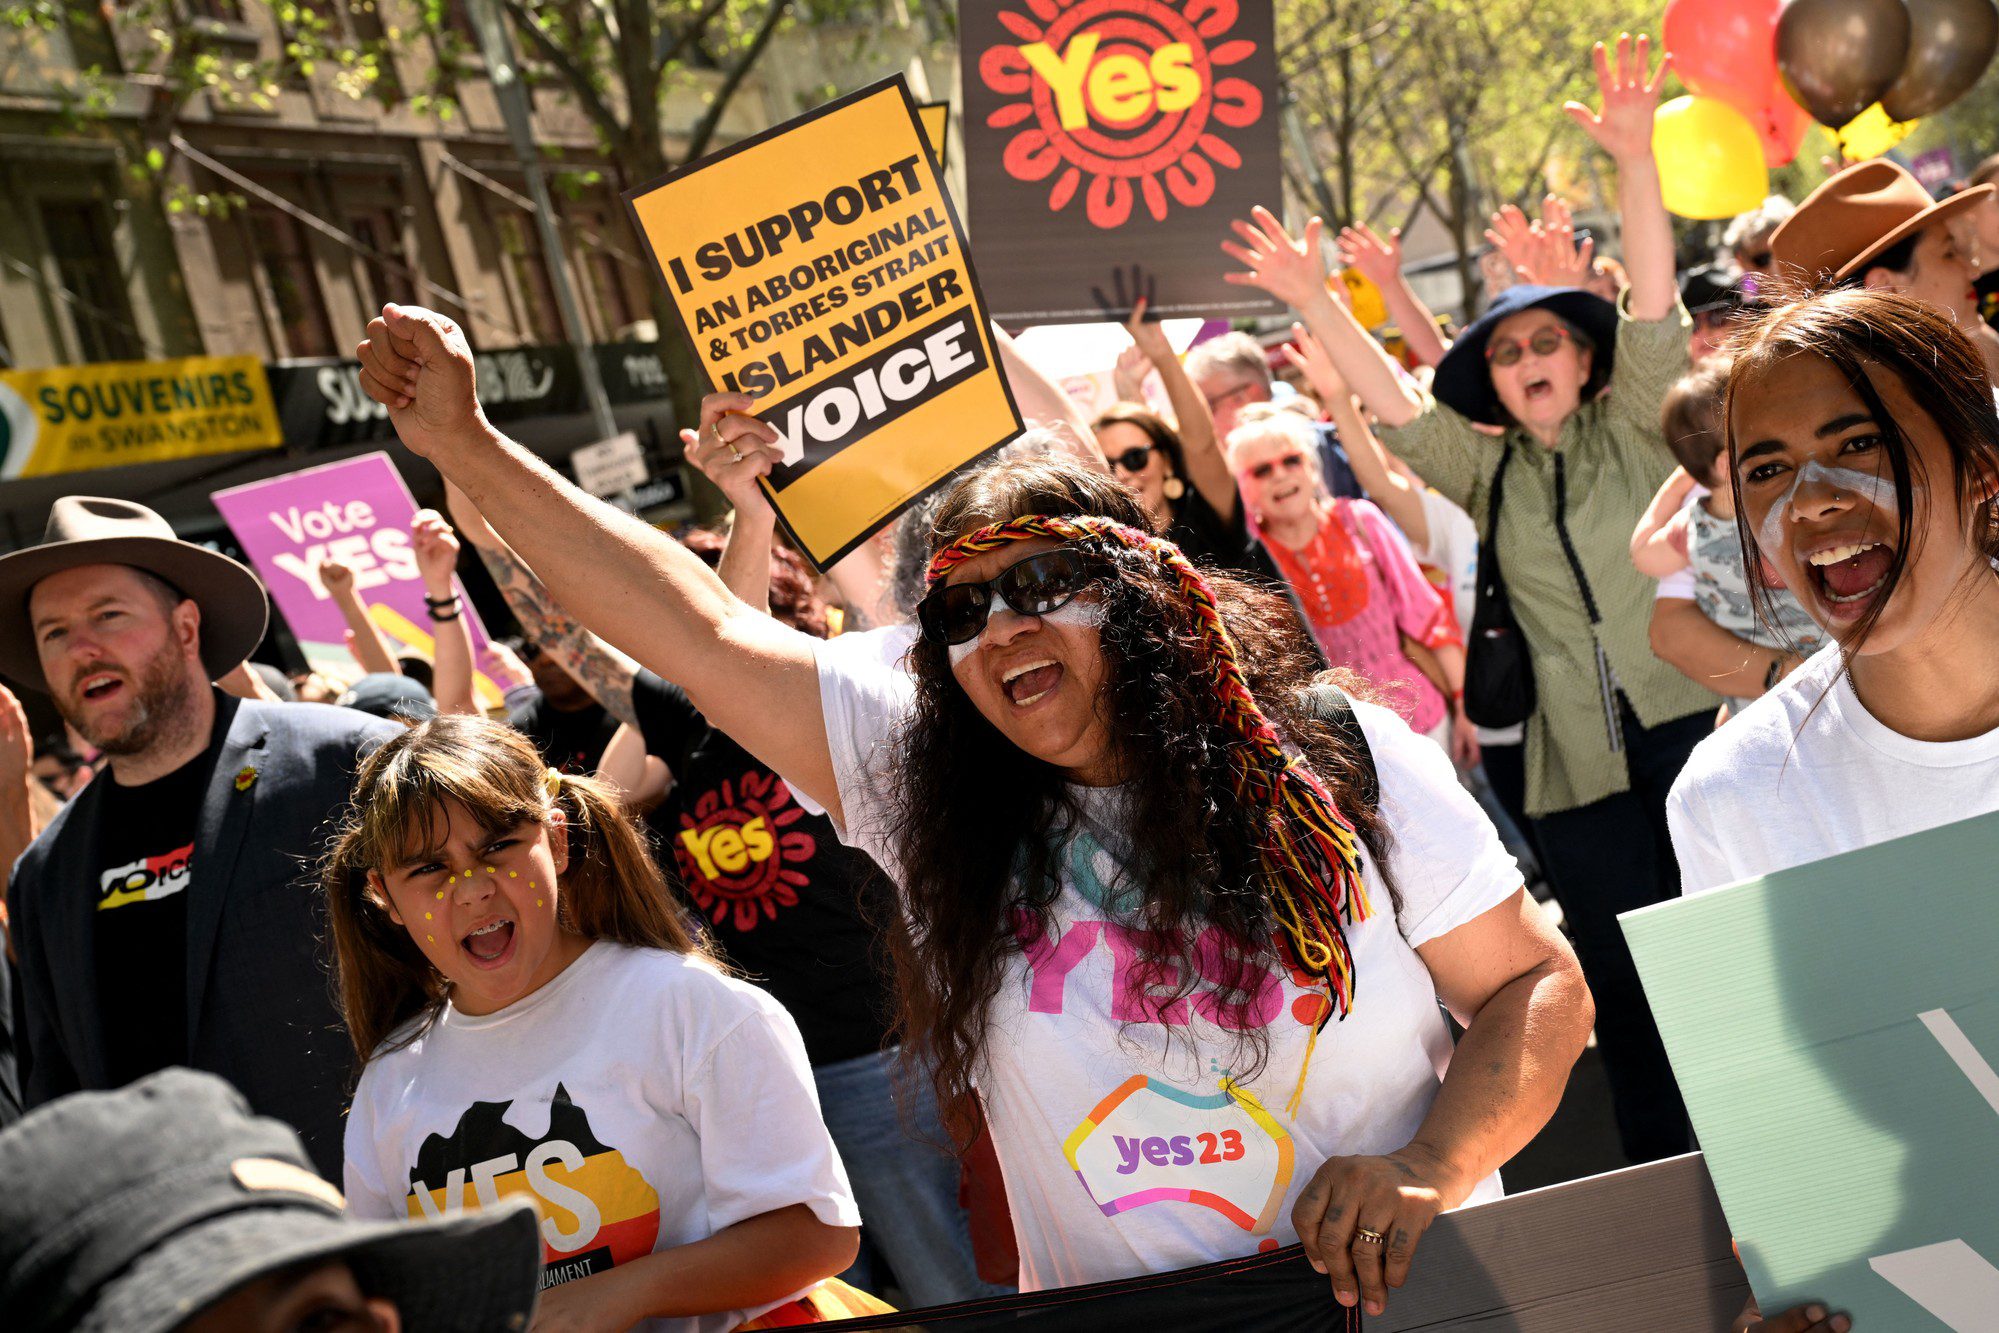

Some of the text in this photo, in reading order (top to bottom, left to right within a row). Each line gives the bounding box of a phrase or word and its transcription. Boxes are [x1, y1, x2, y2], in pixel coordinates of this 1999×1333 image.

[1018, 31, 1203, 131] Yes
[668, 154, 922, 295] I SUPPORT
[695, 206, 946, 334] AN ABORIGINAL
[709, 234, 950, 363] & TORRES STRAIT
[721, 268, 964, 400] ISLANDER
[39, 371, 255, 424] SOUVENIRS
[766, 320, 976, 468] VOICE
[97, 411, 262, 452] SWANSTON
[268, 500, 378, 544] Vote
[272, 527, 423, 601] YES
[680, 815, 774, 881] Yes
[1112, 1129, 1245, 1175] yes23
[537, 1258, 592, 1291] RLIAMENT
